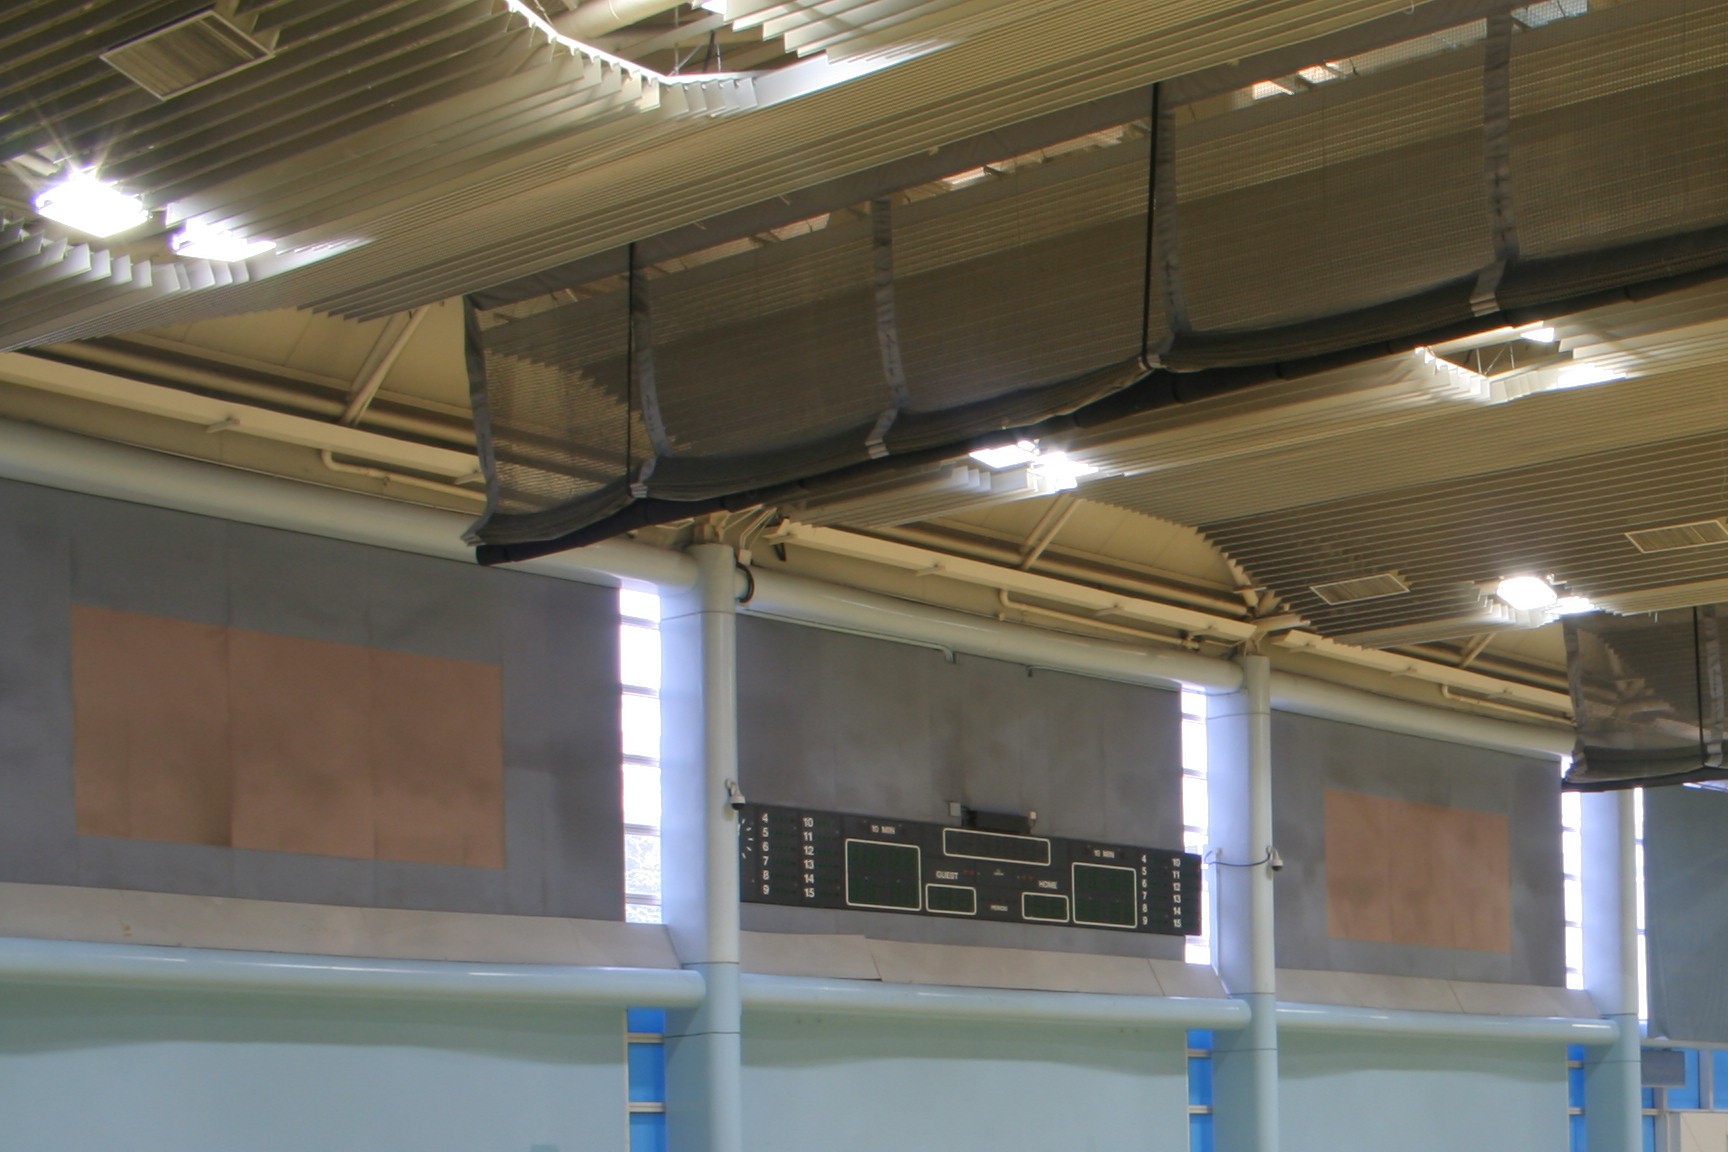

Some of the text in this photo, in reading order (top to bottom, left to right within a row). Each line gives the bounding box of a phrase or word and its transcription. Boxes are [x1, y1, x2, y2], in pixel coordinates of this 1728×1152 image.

[762, 813, 769, 823] 4
[803, 817, 814, 828] 10
[762, 827, 769, 837] 5
[803, 831, 813, 841] 11
[762, 841, 769, 852] 6
[804, 845, 814, 856] 12
[762, 856, 769, 866] 7
[1141, 854, 1147, 863] 4
[1172, 858, 1181, 867] 10
[804, 859, 815, 870] 13
[763, 870, 770, 880] 8
[935, 870, 959, 880] GUEST
[1142, 866, 1147, 876] 5
[1172, 870, 1180, 879] 11
[804, 873, 815, 884] 14
[1142, 879, 1147, 888] 6
[763, 884, 770, 895] 9
[1173, 882, 1181, 891] 12
[804, 887, 815, 898] 15
[1142, 891, 1148, 900] 7
[1173, 894, 1181, 903] 13
[1142, 903, 1148, 913] 8
[1173, 906, 1181, 915] 14
[1142, 916, 1148, 926] 9
[1173, 919, 1182, 928] 15
